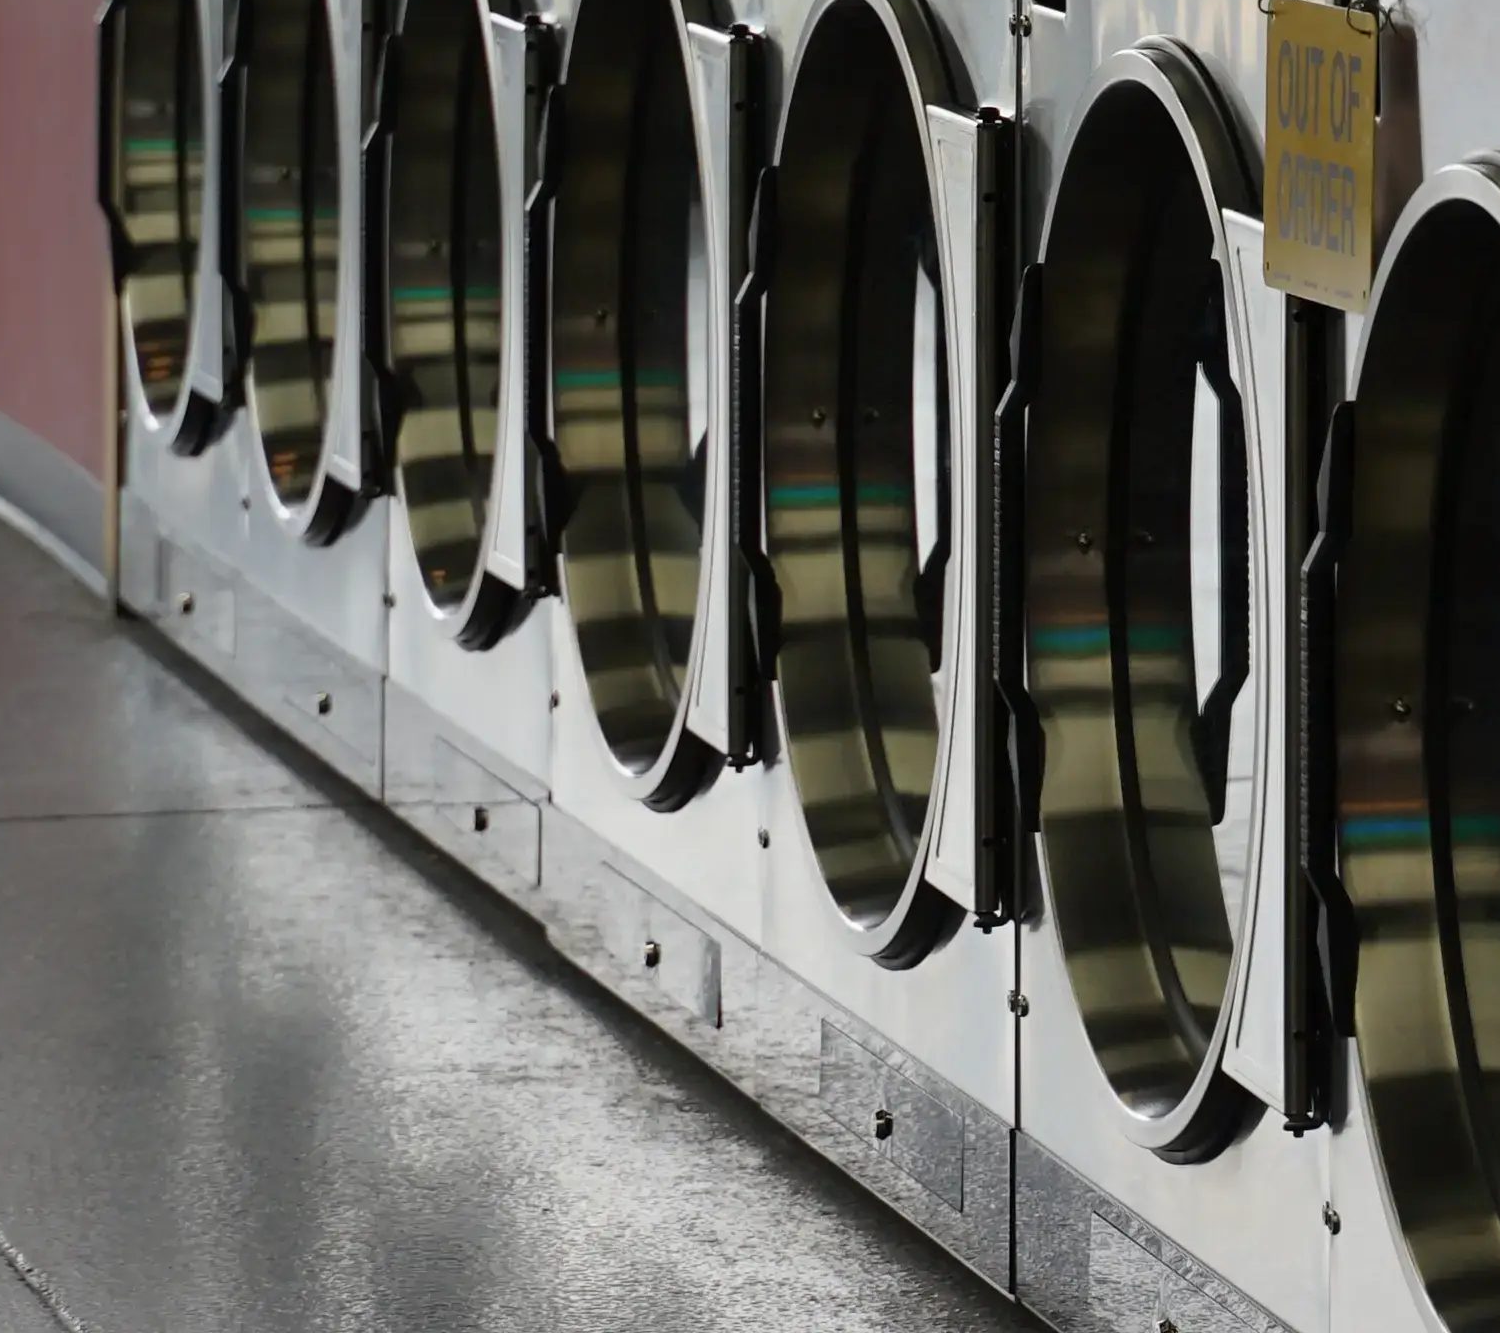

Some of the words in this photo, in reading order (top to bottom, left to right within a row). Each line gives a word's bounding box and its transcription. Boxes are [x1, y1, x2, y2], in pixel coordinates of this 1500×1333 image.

[1277, 39, 1324, 136] OUT
[1330, 51, 1362, 143] OF
[1276, 151, 1355, 257] ORDER
